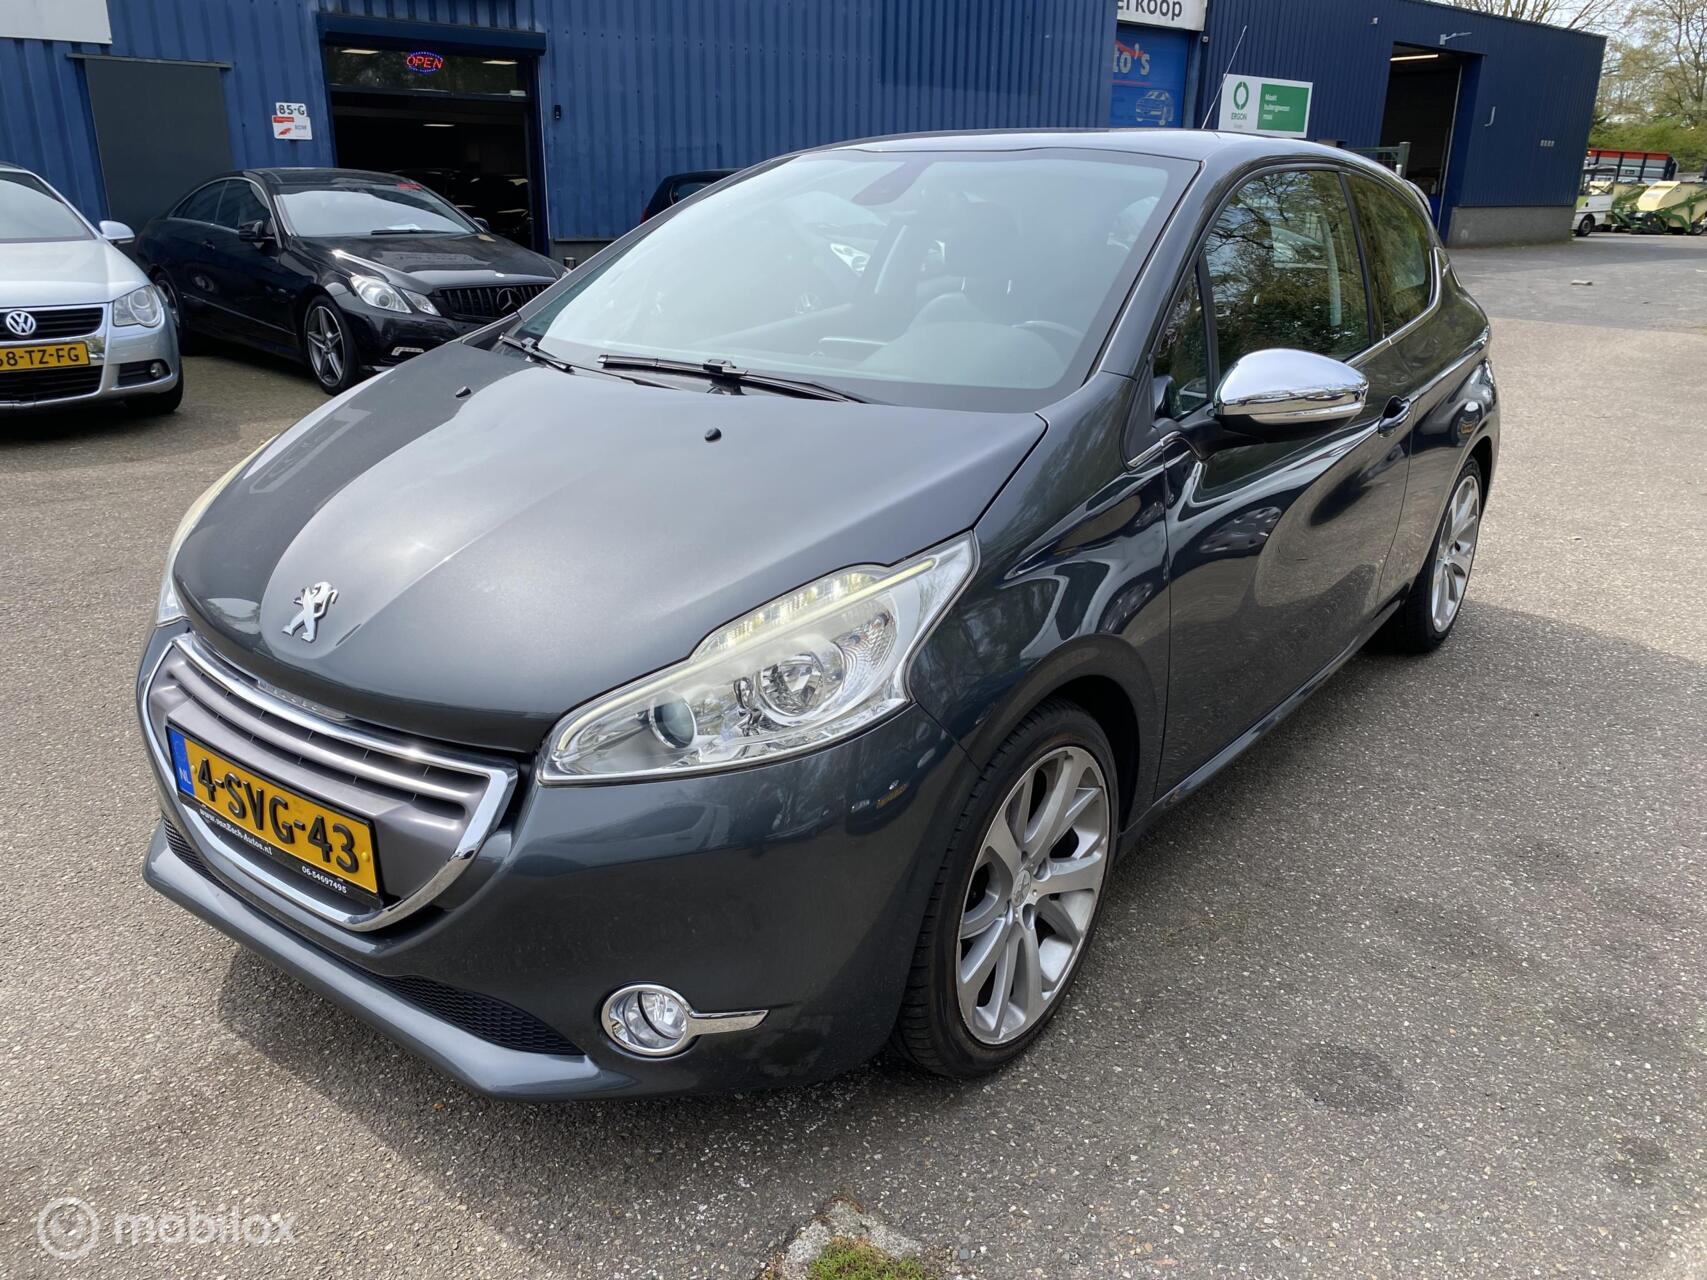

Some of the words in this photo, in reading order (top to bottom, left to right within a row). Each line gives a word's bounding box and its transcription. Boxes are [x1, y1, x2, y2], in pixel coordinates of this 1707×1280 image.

[407, 56, 442, 69] OPEN
[278, 104, 306, 116] 85-G
[1231, 112, 1248, 121] ERGON
[178, 767, 192, 785] NL
[198, 757, 360, 874] 4-SVG-43
